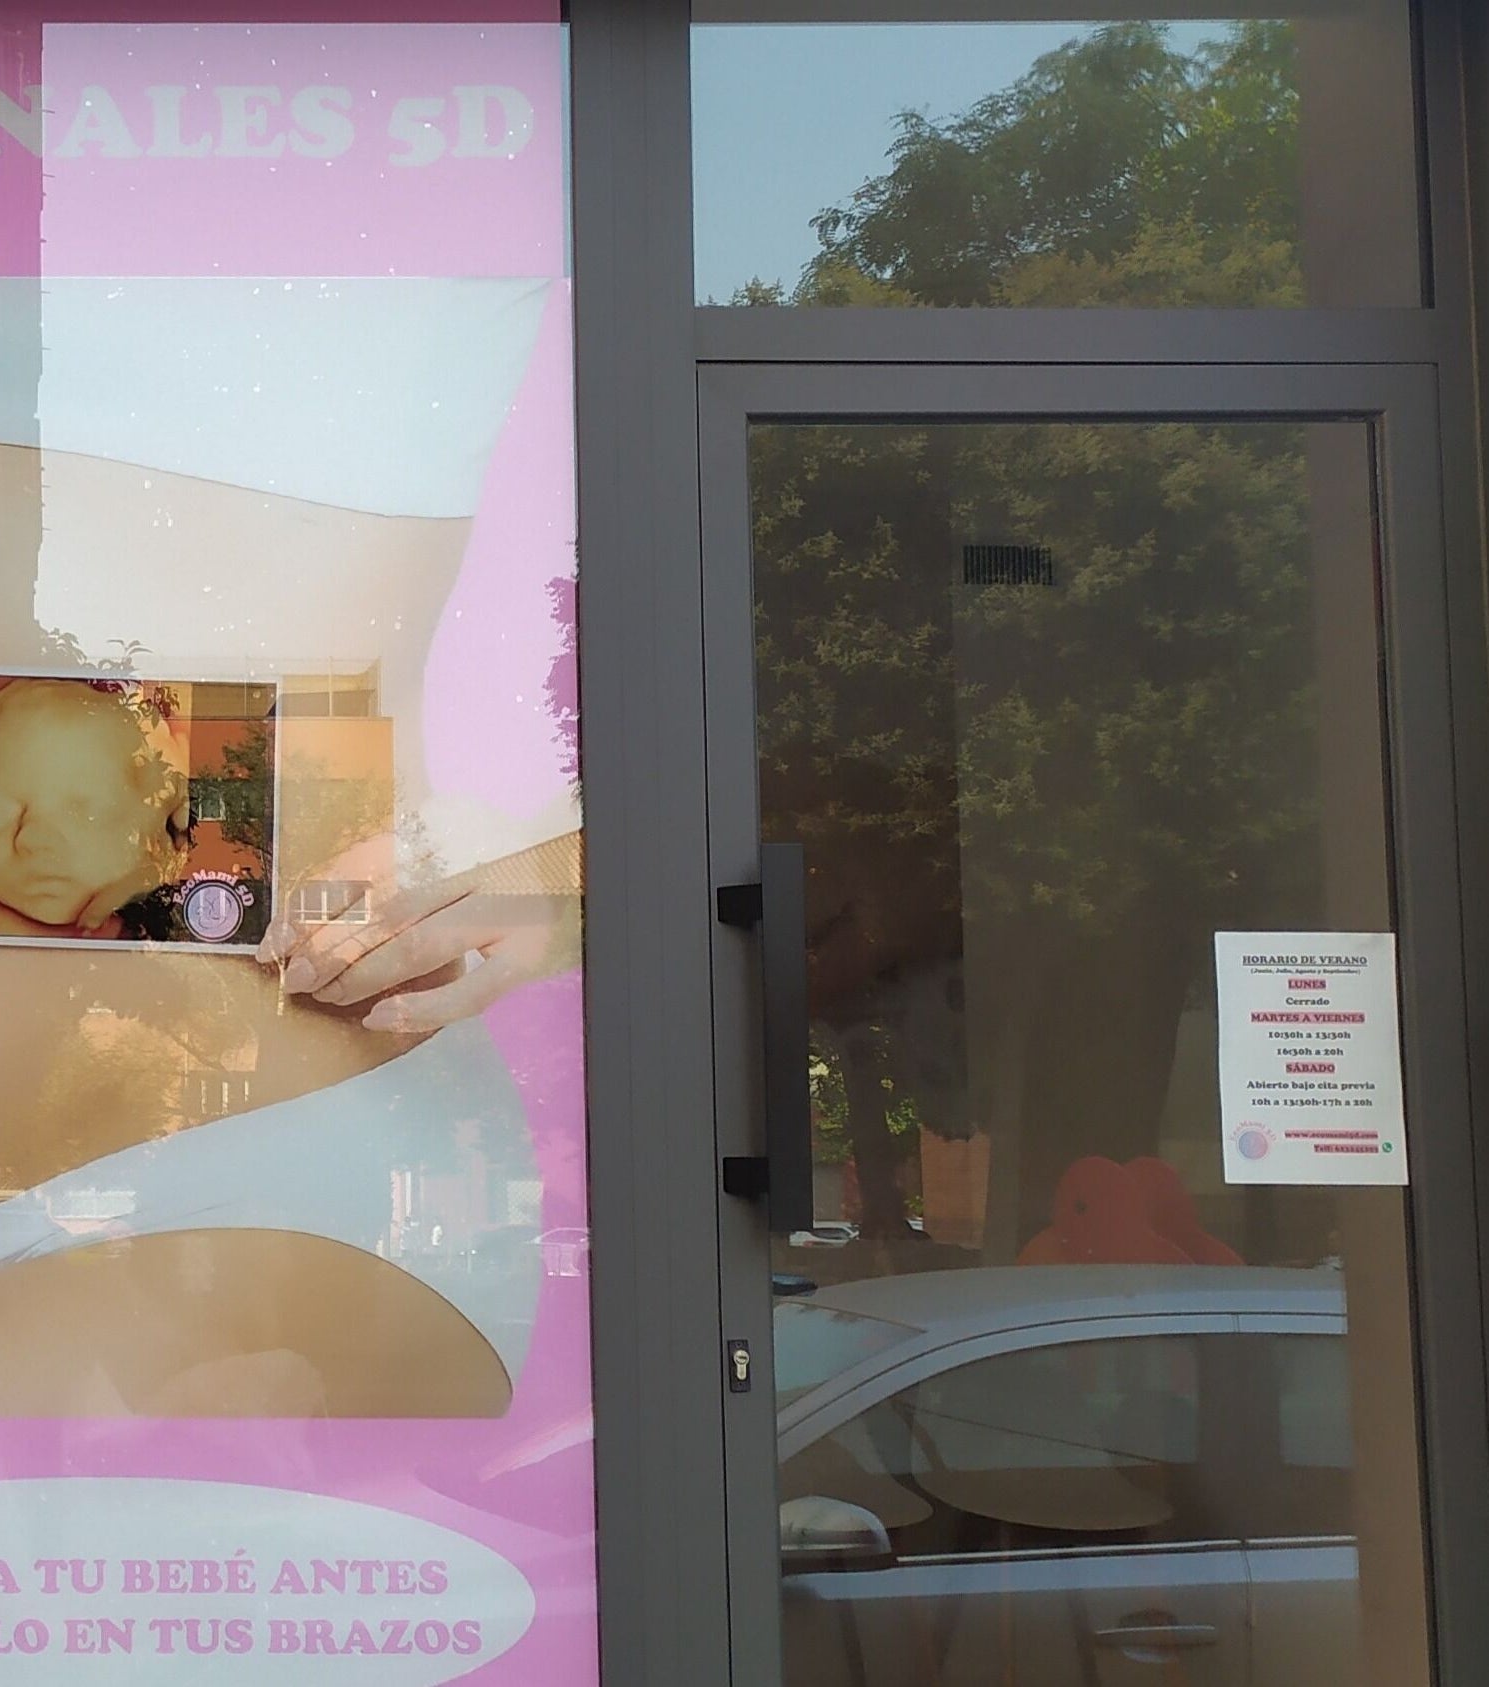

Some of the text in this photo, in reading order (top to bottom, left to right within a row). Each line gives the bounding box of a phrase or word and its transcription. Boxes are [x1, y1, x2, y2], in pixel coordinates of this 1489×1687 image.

[387, 84, 536, 168] 5D
[1242, 955, 1368, 965] HORARIO DE VERANO
[1288, 980, 1326, 989] LUNES
[1285, 997, 1330, 1006] Cerrado
[1251, 1013, 1365, 1023] MARTES A VIERNES
[1268, 1031, 1304, 1039] 10:30h
[1315, 1031, 1351, 1040] 13:30h
[1277, 1047, 1312, 1056] 16:30h
[1324, 1047, 1344, 1056] 20h
[1285, 1062, 1335, 1073] SÁBADO
[1246, 1080, 1375, 1091] Abierto bajo cita previa
[1251, 1097, 1271, 1106] 10h
[1353, 1098, 1373, 1107] 20h
[33, 1558, 108, 1595] TU
[120, 1548, 257, 1596] BEBÉ
[269, 1559, 449, 1596] ANTES
[63, 1618, 135, 1656] EN
[148, 1618, 254, 1656] TUS
[268, 1618, 483, 1656] BRAZOS
